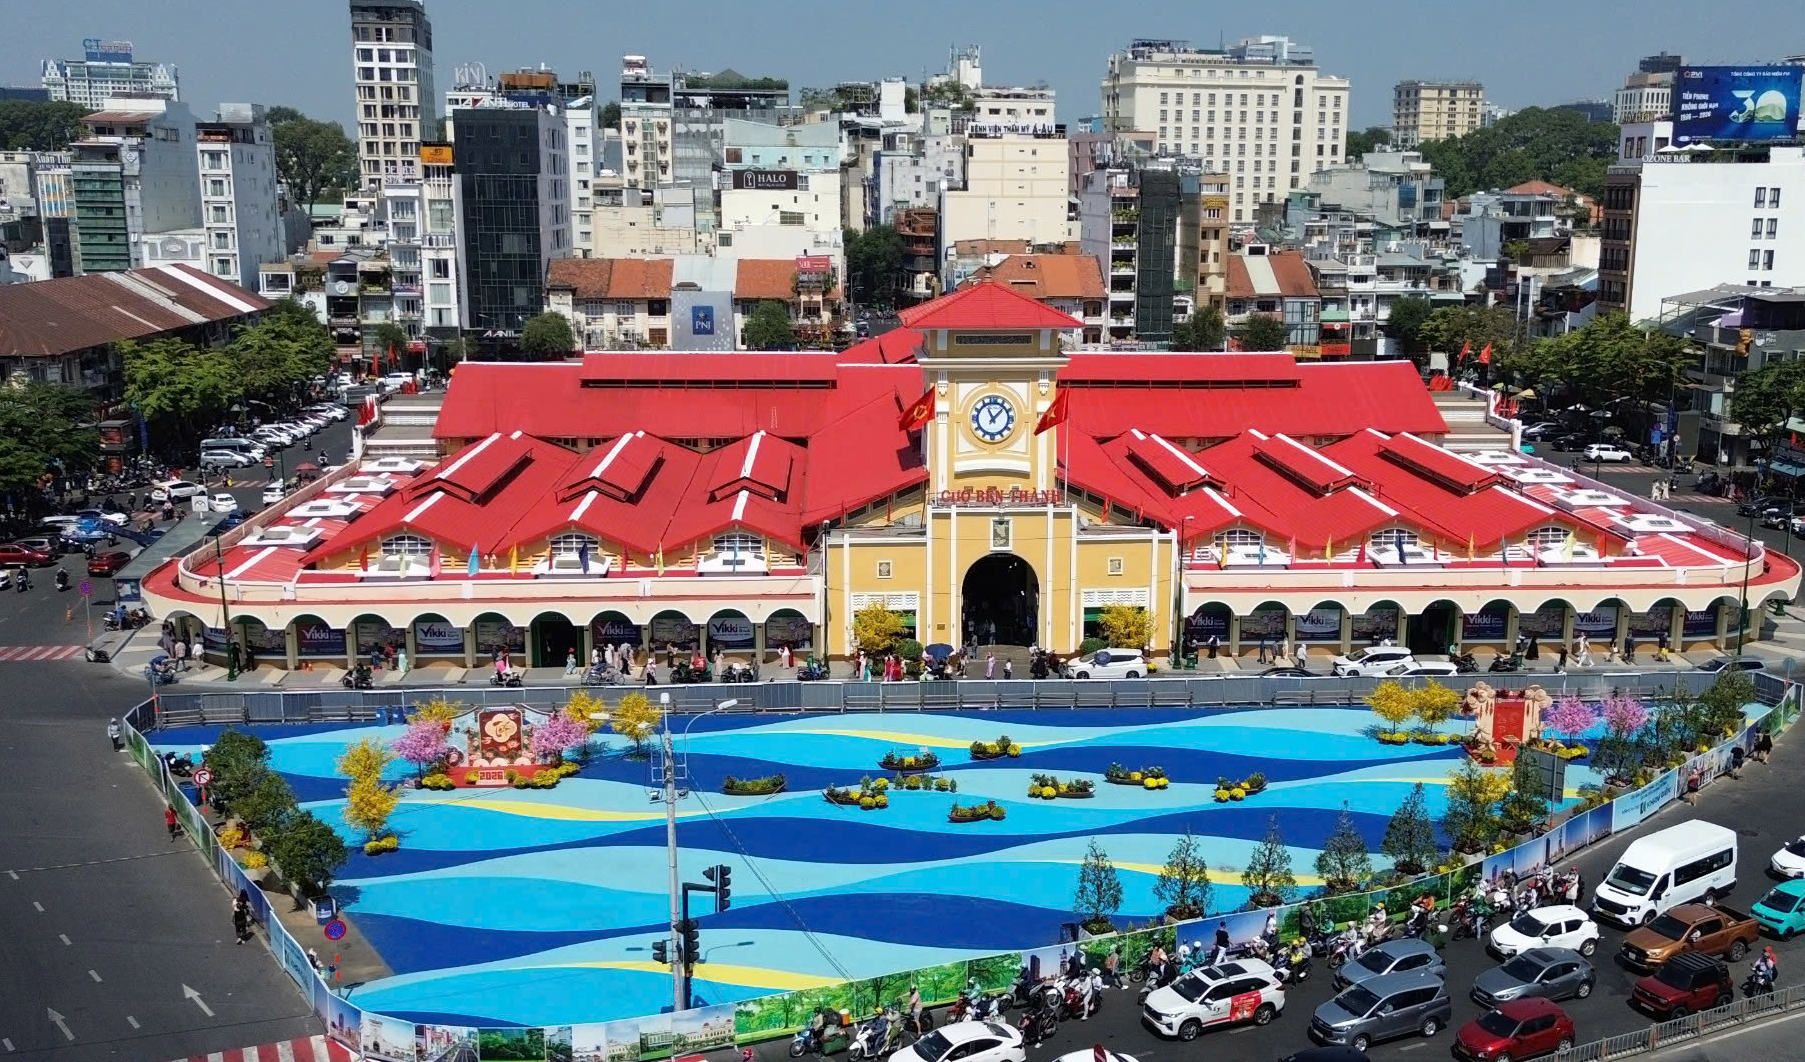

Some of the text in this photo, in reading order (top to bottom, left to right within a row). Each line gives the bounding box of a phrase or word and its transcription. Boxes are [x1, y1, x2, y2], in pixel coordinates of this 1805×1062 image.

[1642, 155, 1691, 163] OZONE BAR
[758, 174, 787, 183] HALO
[695, 320, 711, 330] PNJ
[302, 625, 329, 639] Vikki
[420, 624, 447, 638] Vikki
[597, 621, 623, 635] Vikki
[713, 619, 738, 633] Vikki
[479, 771, 503, 780] 2026
